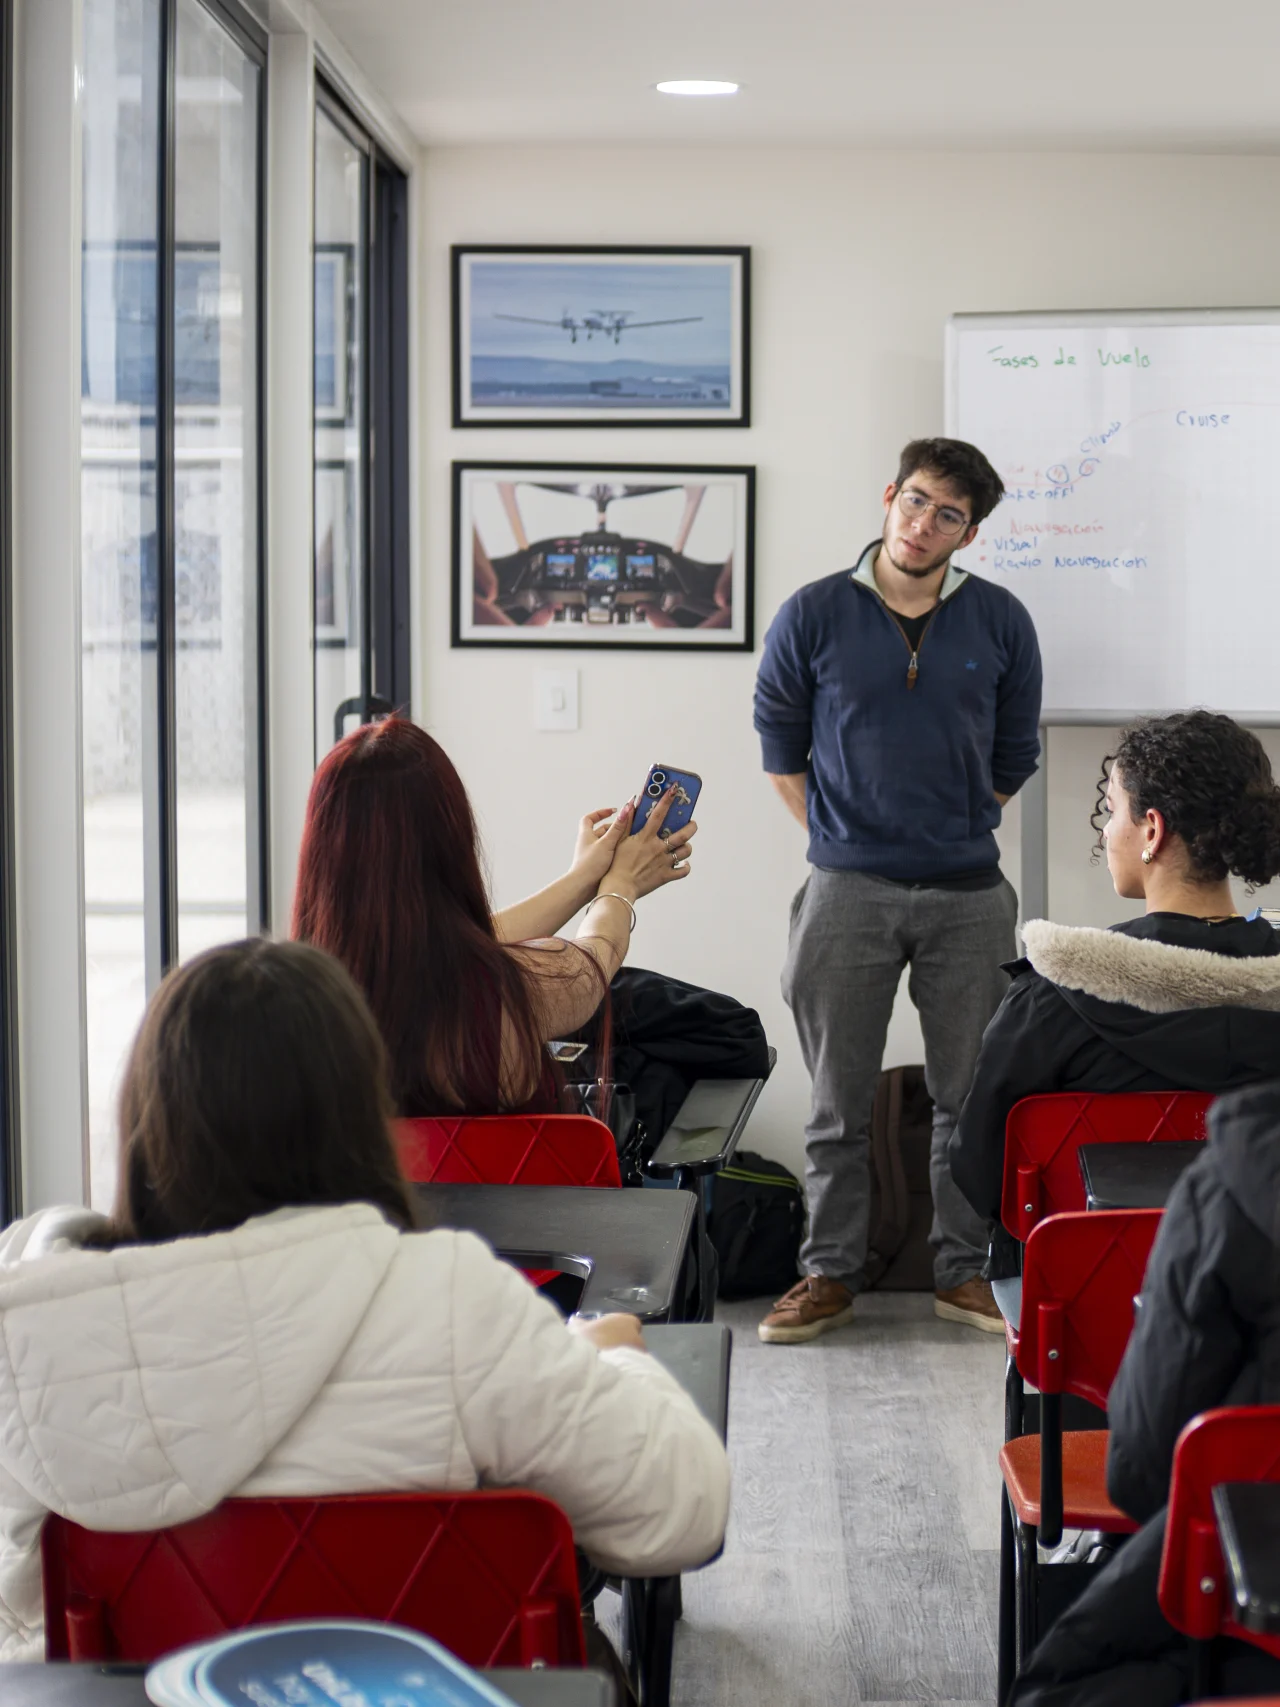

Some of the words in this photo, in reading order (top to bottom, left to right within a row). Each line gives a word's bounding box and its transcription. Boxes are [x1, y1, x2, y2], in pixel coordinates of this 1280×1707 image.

[987, 345, 1039, 368] Fases
[1053, 347, 1077, 366] de
[1098, 346, 1151, 368] Vuelo
[1176, 410, 1231, 429] Cruise
[1080, 420, 1122, 453] Climb
[994, 536, 1038, 552] Visual
[994, 554, 1042, 571] Radio
